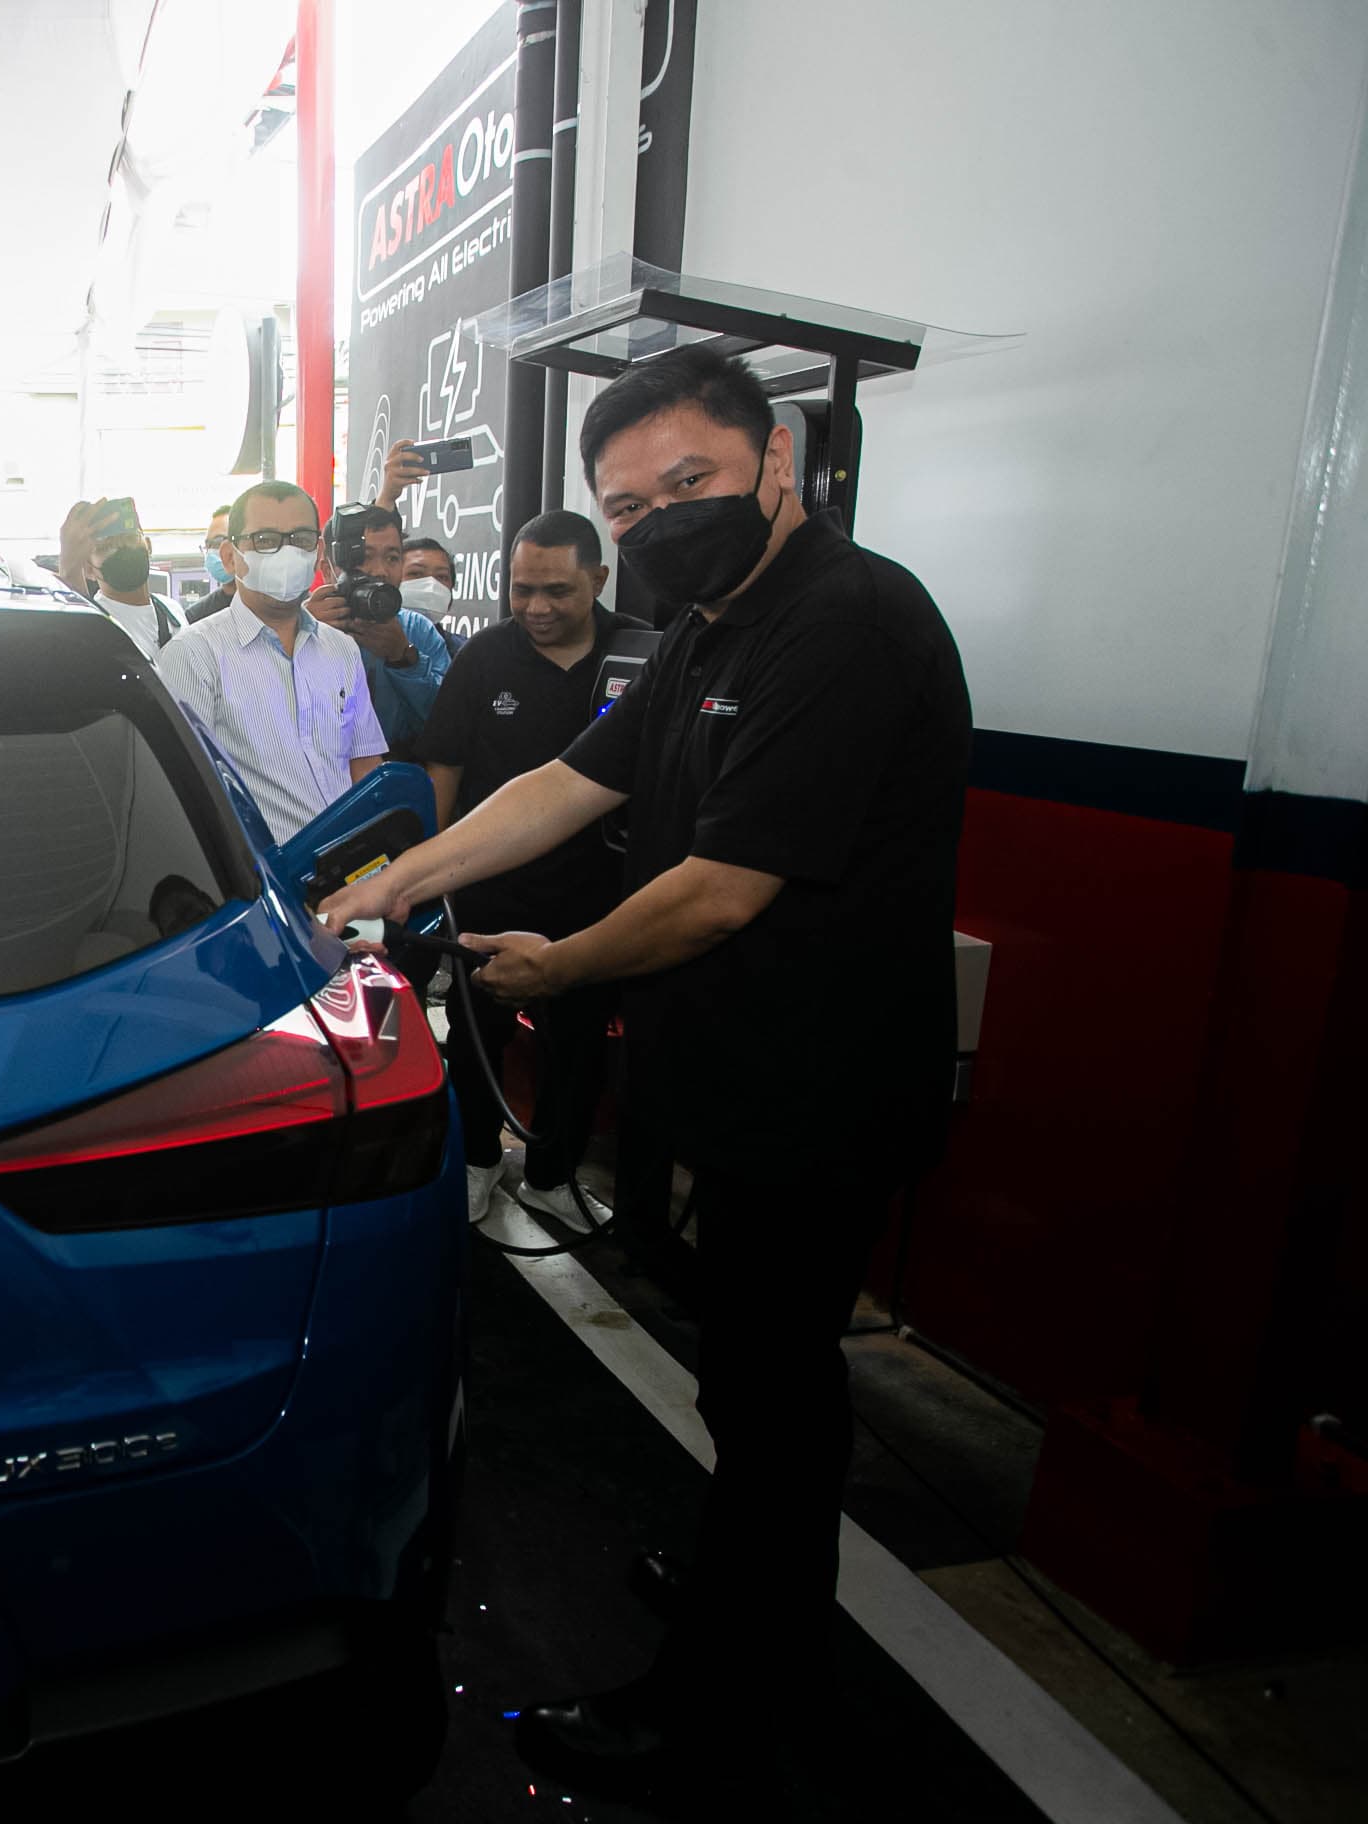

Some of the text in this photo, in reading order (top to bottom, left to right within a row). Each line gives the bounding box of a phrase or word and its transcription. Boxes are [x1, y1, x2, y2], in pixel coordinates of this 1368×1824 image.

[368, 109, 515, 272] ASTRAOto
[360, 208, 512, 334] Powering All Electri
[451, 550, 502, 601] GING
